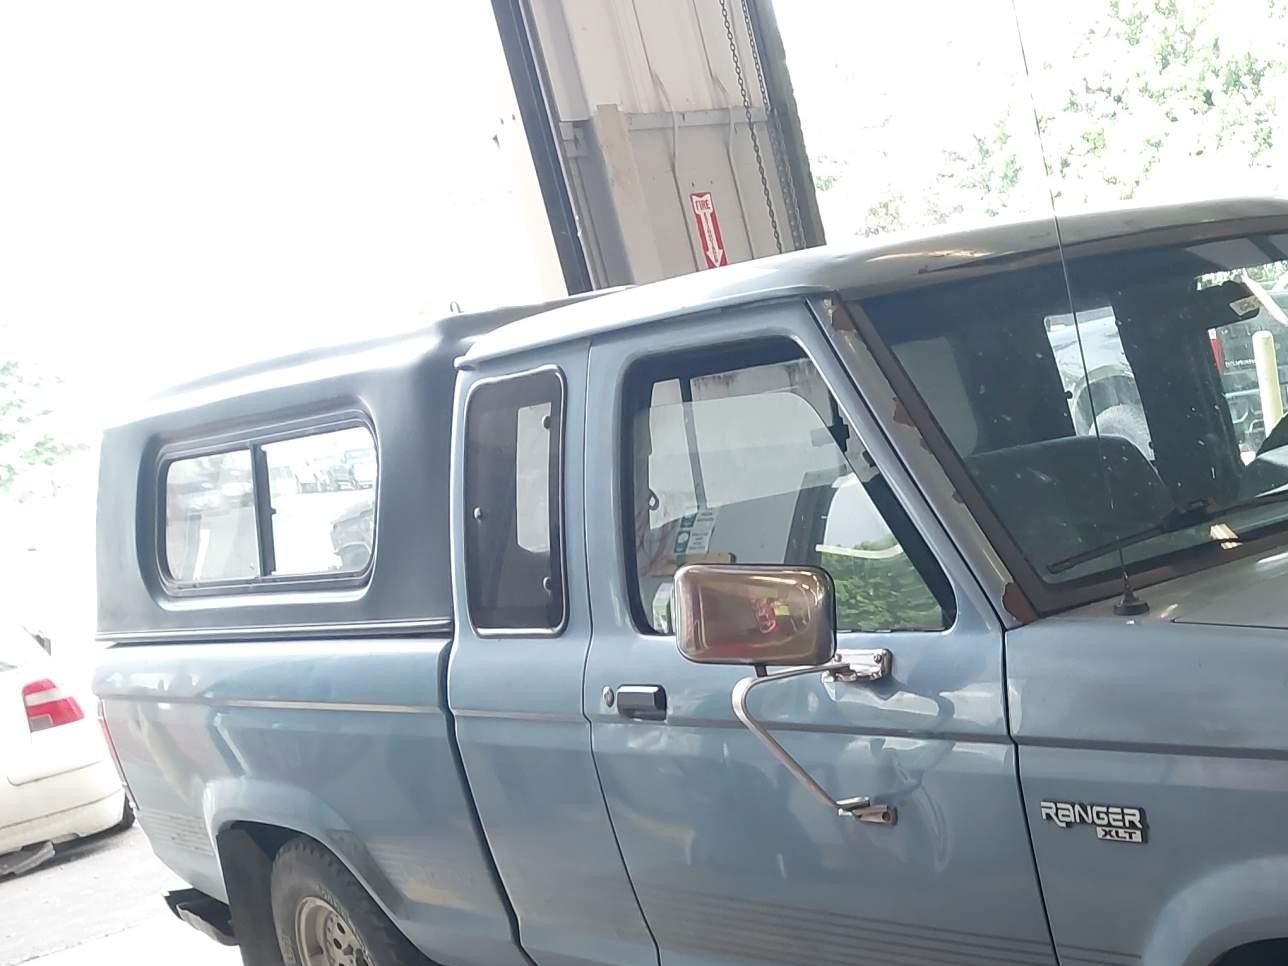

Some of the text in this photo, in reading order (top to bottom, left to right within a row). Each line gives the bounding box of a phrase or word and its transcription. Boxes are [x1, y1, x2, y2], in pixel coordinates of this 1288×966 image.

[695, 199, 711, 211] FIRE
[1040, 801, 1143, 828] RANGER
[1100, 827, 1139, 841] XLT
